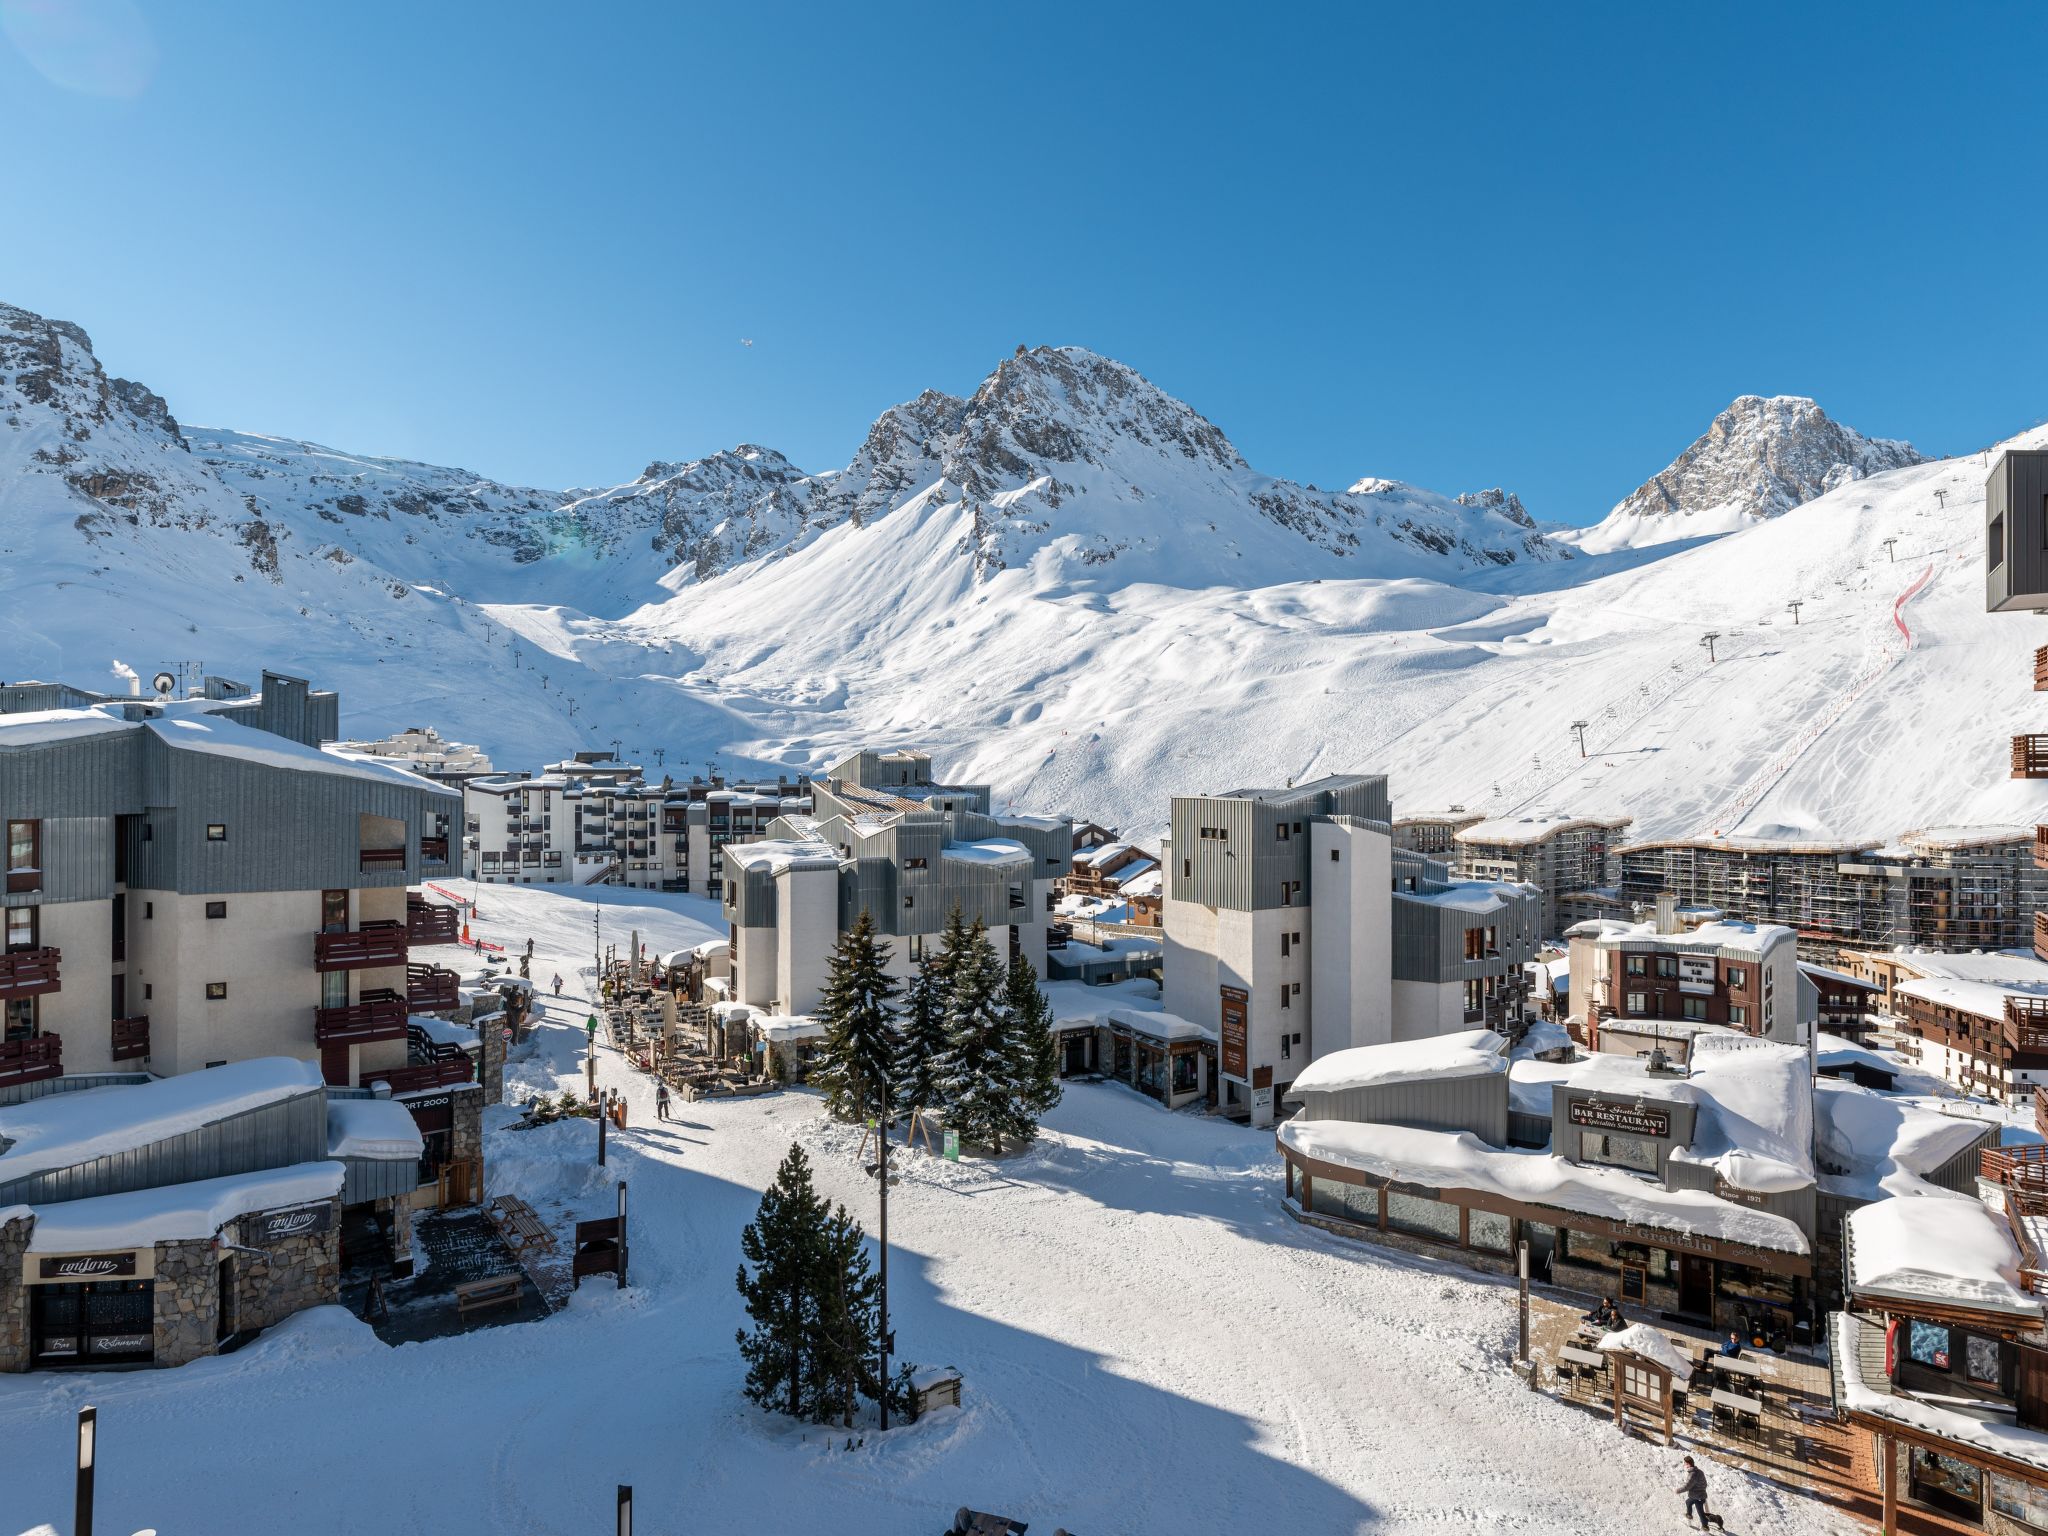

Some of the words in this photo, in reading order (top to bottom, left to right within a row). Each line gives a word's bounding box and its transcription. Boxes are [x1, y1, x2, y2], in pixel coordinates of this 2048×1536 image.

[1682, 960, 1711, 968] HOTEL
[404, 1101, 421, 1109] ORT
[423, 1097, 449, 1107] 2000
[1574, 1108, 1594, 1118] BAR
[1596, 1112, 1665, 1129] RESTAURANT
[1720, 1190, 1740, 1199] Since
[1747, 1194, 1761, 1203] 1971
[1610, 1222, 1632, 1236] Le
[1637, 1227, 1713, 1252] Grattalu
[53, 1338, 70, 1350] Bar
[97, 1335, 145, 1350] Restaurant
